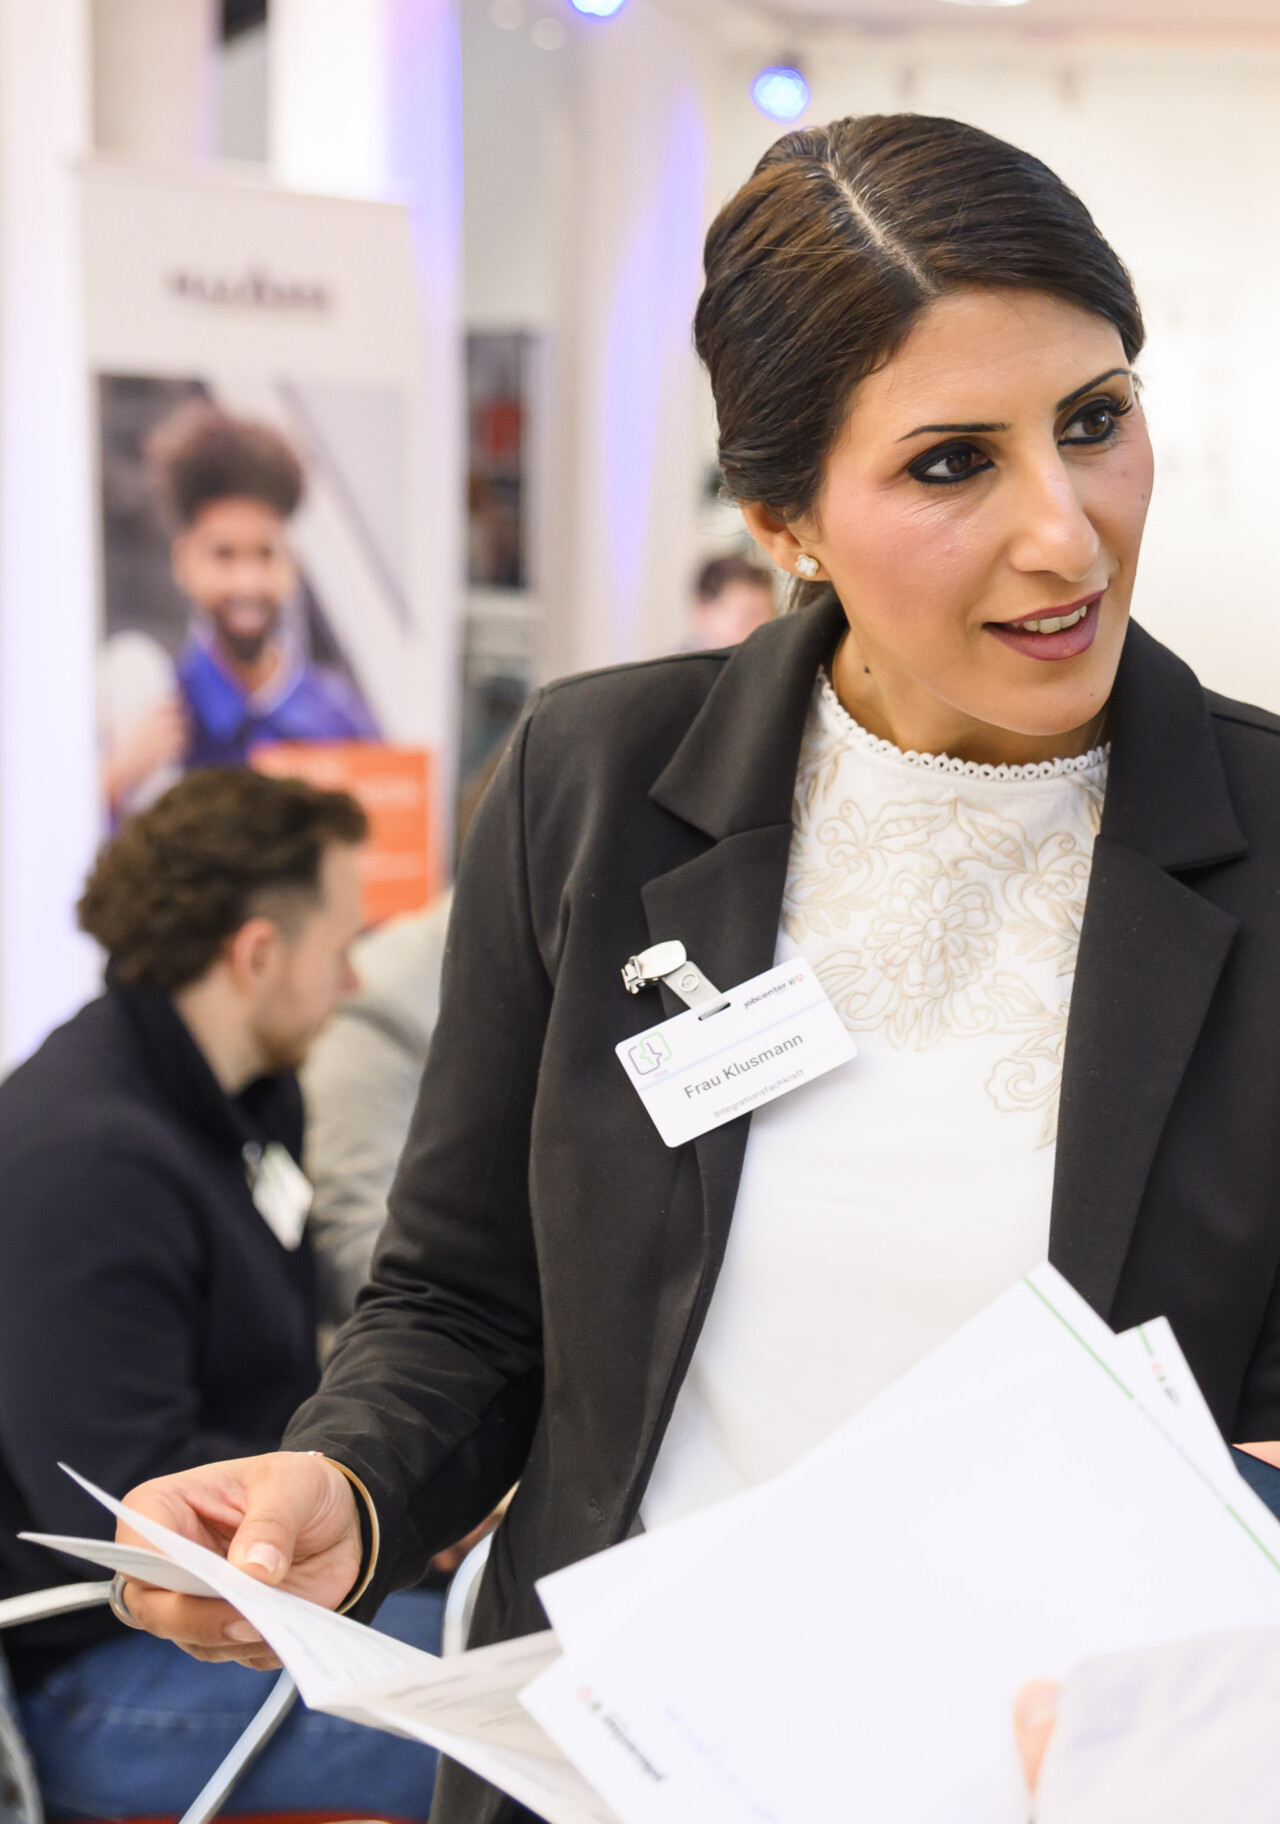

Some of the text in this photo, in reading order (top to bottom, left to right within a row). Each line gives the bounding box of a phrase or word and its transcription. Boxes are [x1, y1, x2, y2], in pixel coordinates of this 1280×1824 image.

[743, 981, 786, 1009] jobcenter
[683, 1033, 804, 1099] Frau Klusmann
[713, 1069, 805, 1118] Integrationsfachkraft
